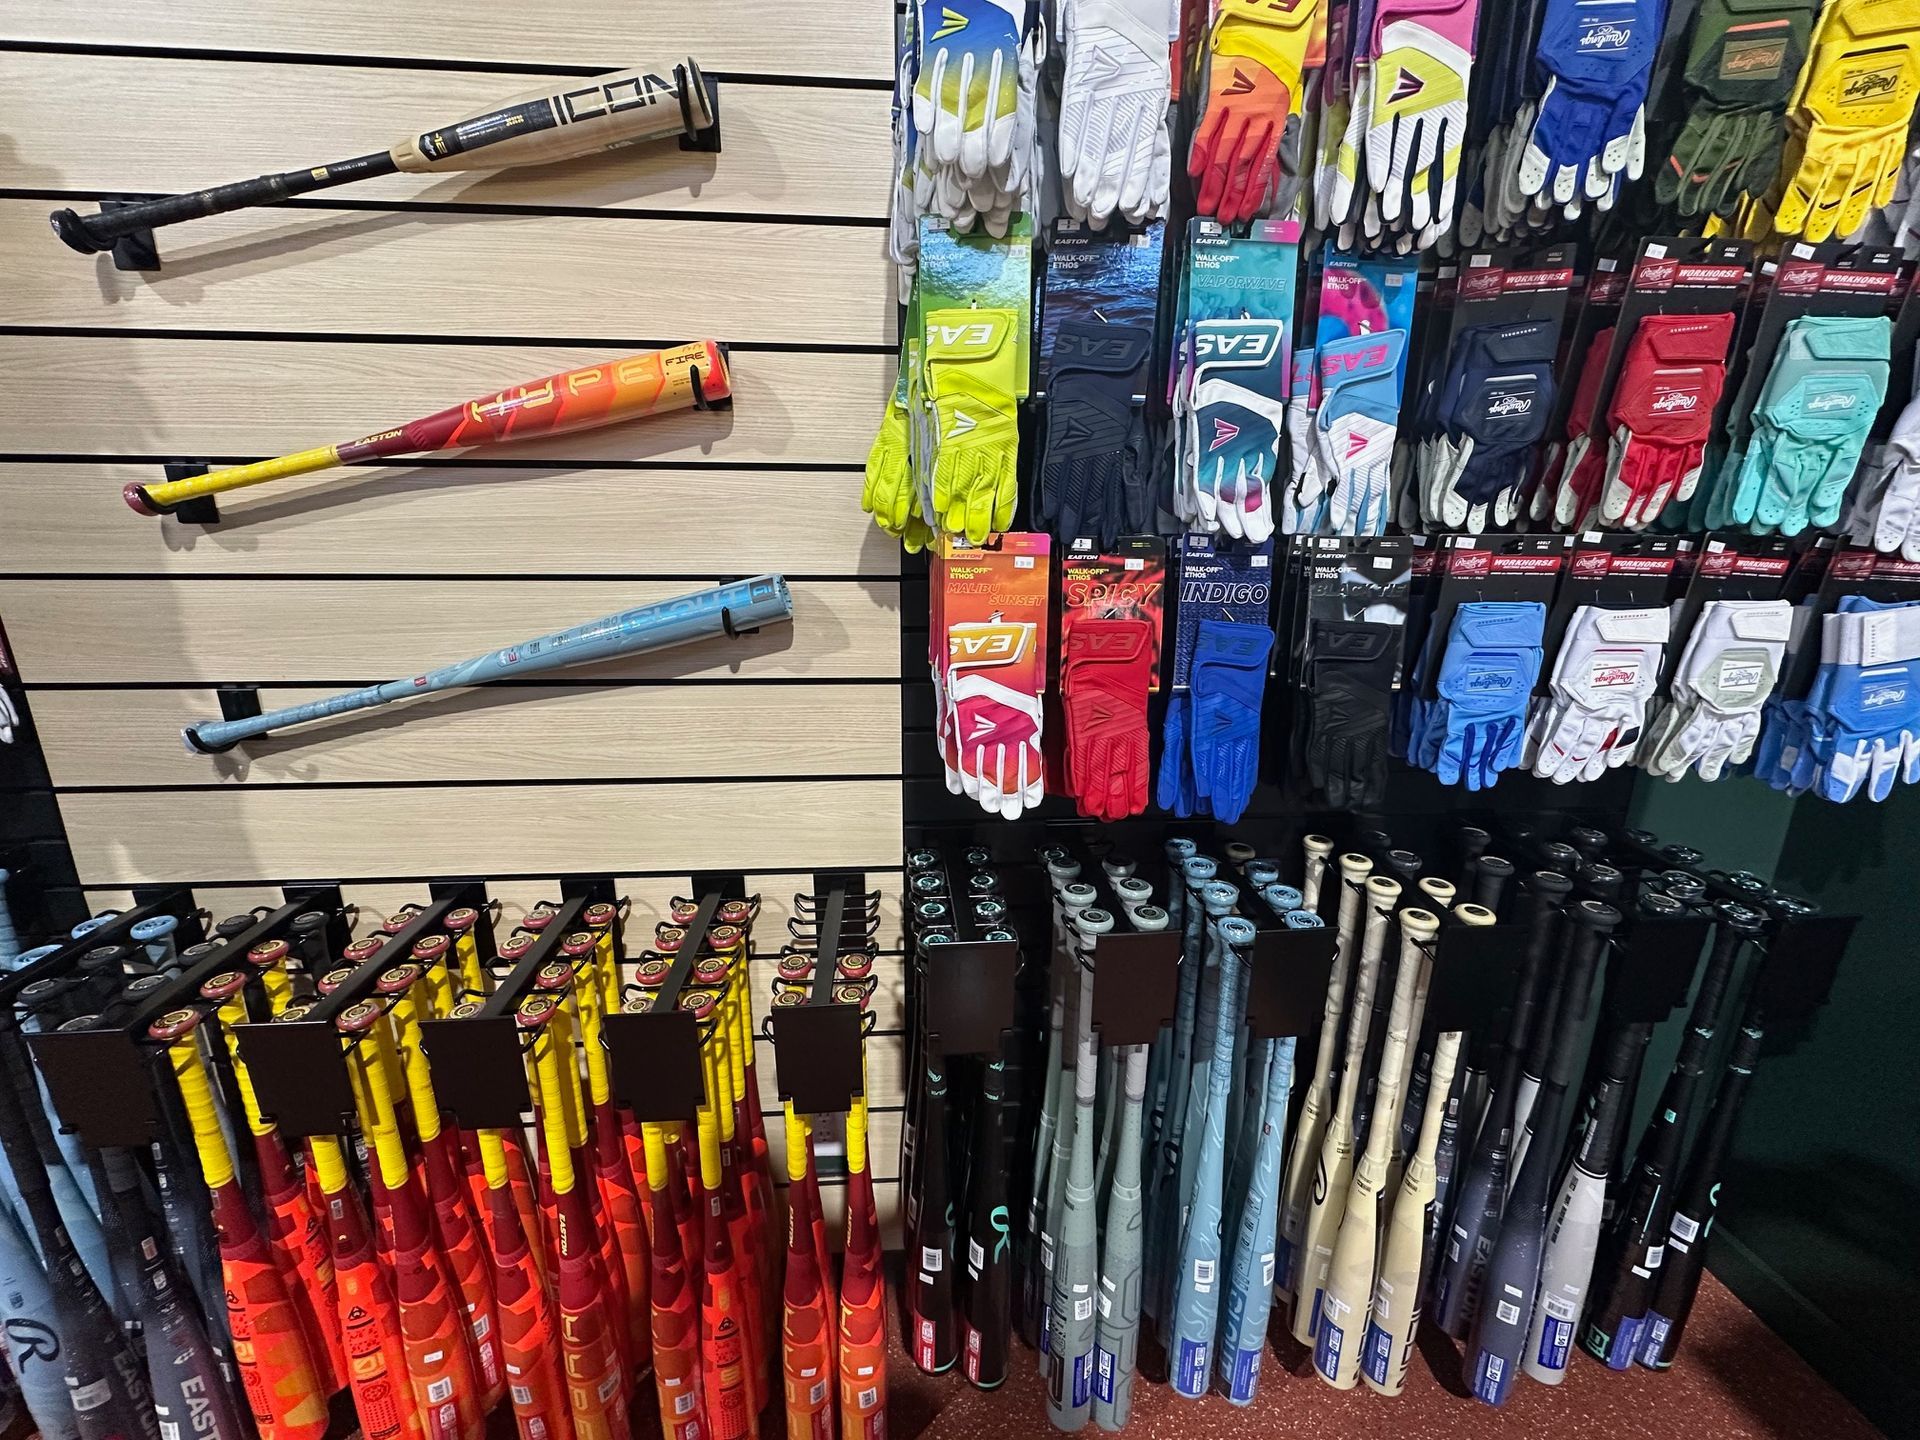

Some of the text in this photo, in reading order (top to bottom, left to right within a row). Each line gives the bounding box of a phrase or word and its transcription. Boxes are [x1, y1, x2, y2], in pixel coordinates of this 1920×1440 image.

[1580, 27, 1630, 48] Rawlings
[1726, 48, 1782, 71] Rawlings
[1845, 73, 1898, 98] Rawlings
[553, 70, 680, 126] ICON
[1195, 261, 1220, 269] ETHOS
[1506, 272, 1568, 284] WORKHORSE
[1678, 269, 1739, 278] WORKHORSE
[1825, 274, 1890, 285] WORKHORSE
[1198, 274, 1286, 291] VAPORWAVE
[1327, 282, 1349, 290] ETHOS
[665, 351, 705, 366] FIRE
[1488, 399, 1532, 415] Rawlings
[1652, 393, 1697, 411] Rawlings
[1808, 393, 1856, 410] Rawlings
[354, 430, 402, 448] EASTON
[1494, 559, 1555, 567] WORKHORSE
[1612, 560, 1670, 568] WORKHORSE
[1736, 559, 1786, 569] WORKHORSE
[947, 582, 1000, 593] MALIBU
[1066, 582, 1163, 607] SPICY
[1182, 582, 1269, 605] INDIGO
[989, 594, 1045, 606] SUNSET
[1470, 675, 1512, 689] Rawlings
[1595, 671, 1636, 686] Rawlings
[559, 1213, 568, 1256] EASTON
